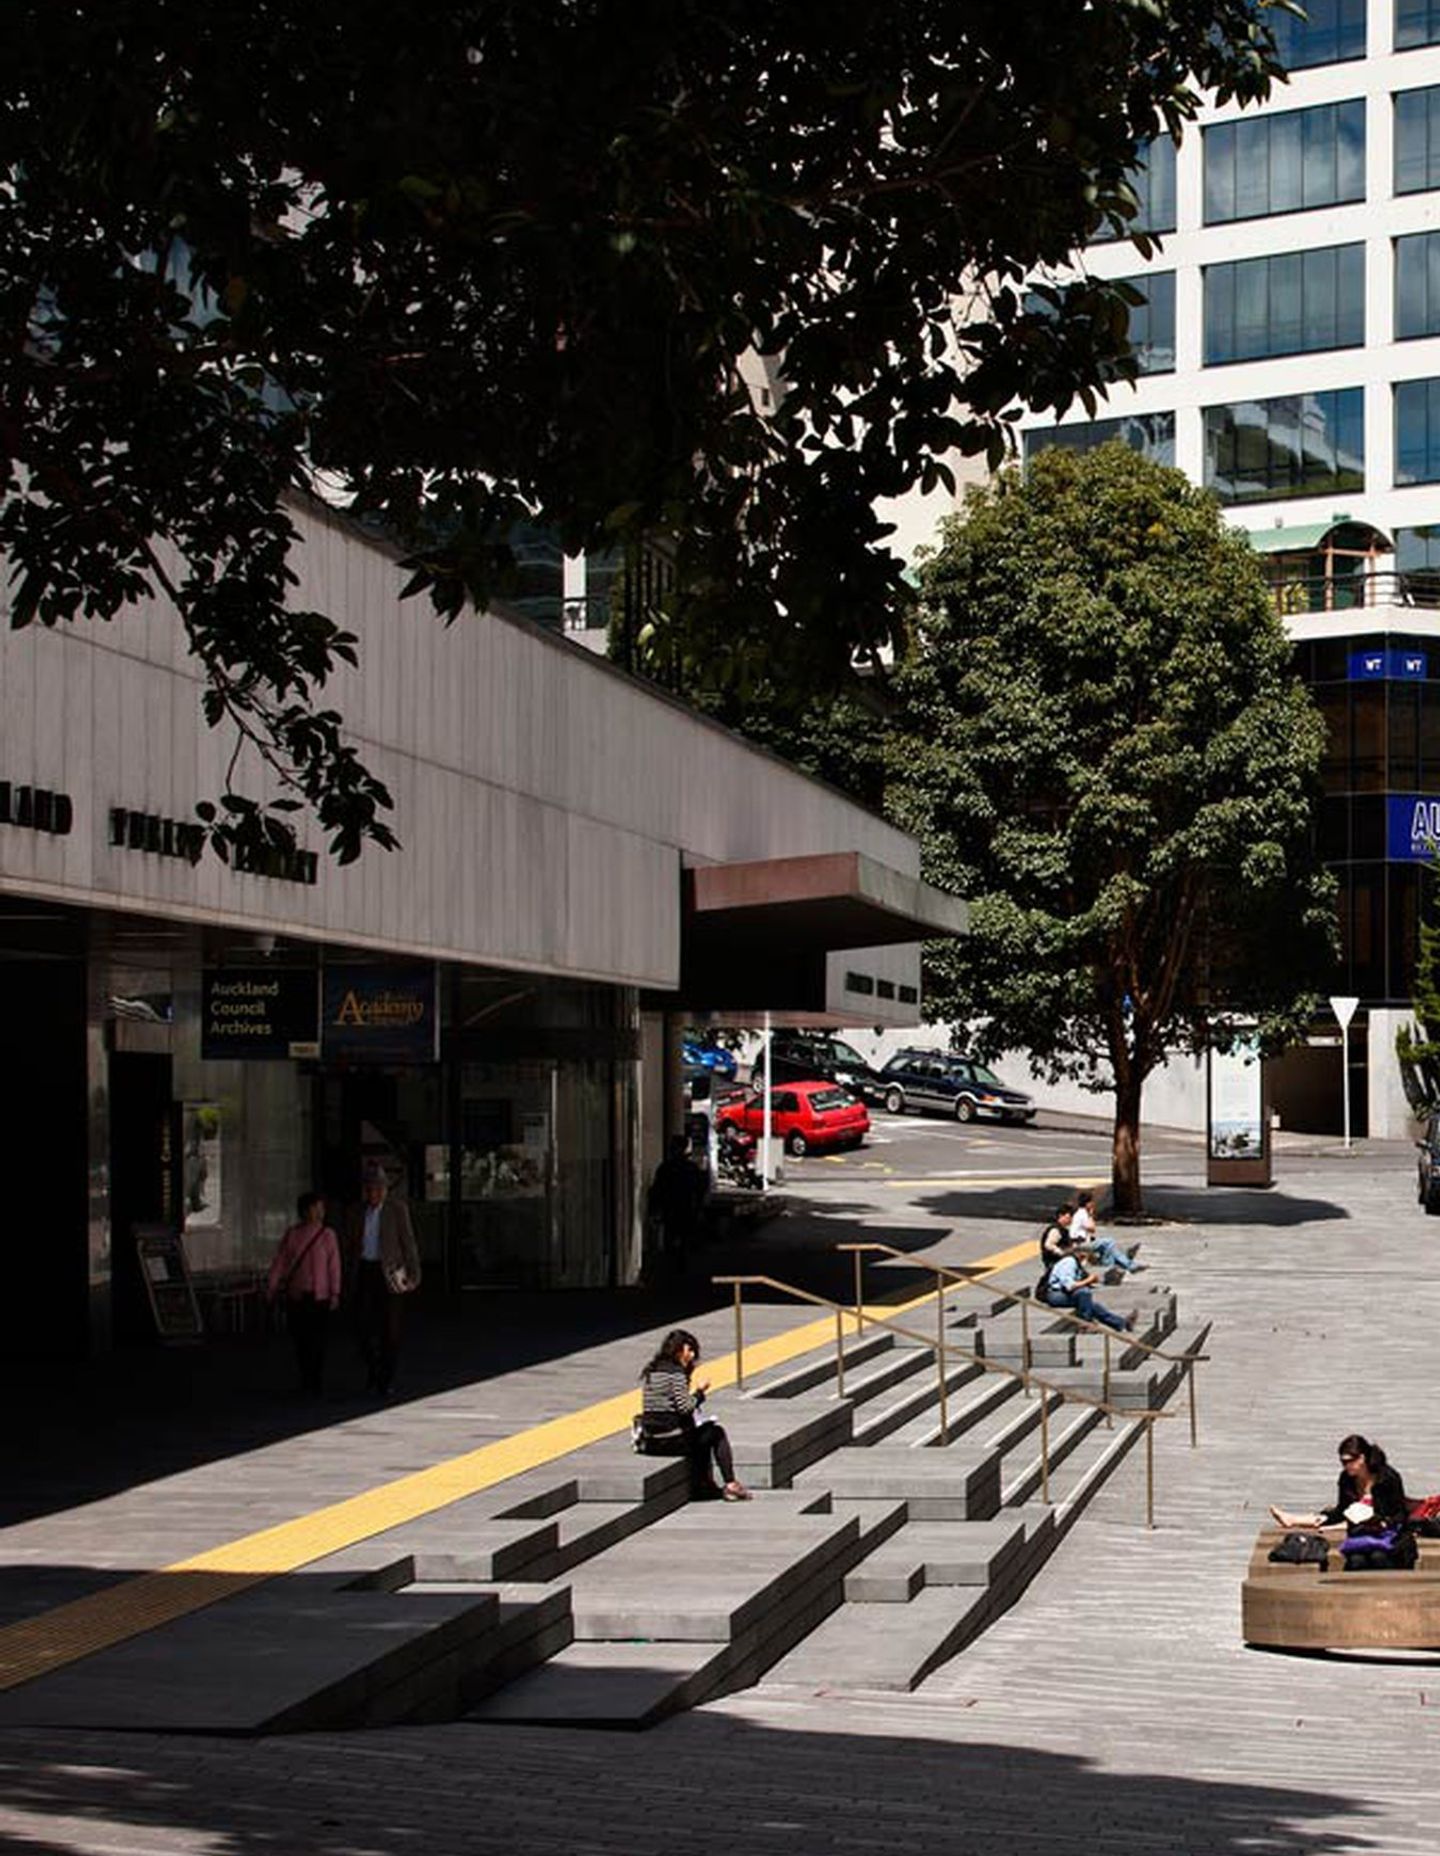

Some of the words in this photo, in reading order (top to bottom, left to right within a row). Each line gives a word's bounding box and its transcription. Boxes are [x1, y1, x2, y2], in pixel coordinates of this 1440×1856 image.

[211, 981, 279, 997] Auckland
[211, 1001, 265, 1016] Council
[331, 989, 424, 1026] Academy
[211, 1020, 272, 1035] Archives
